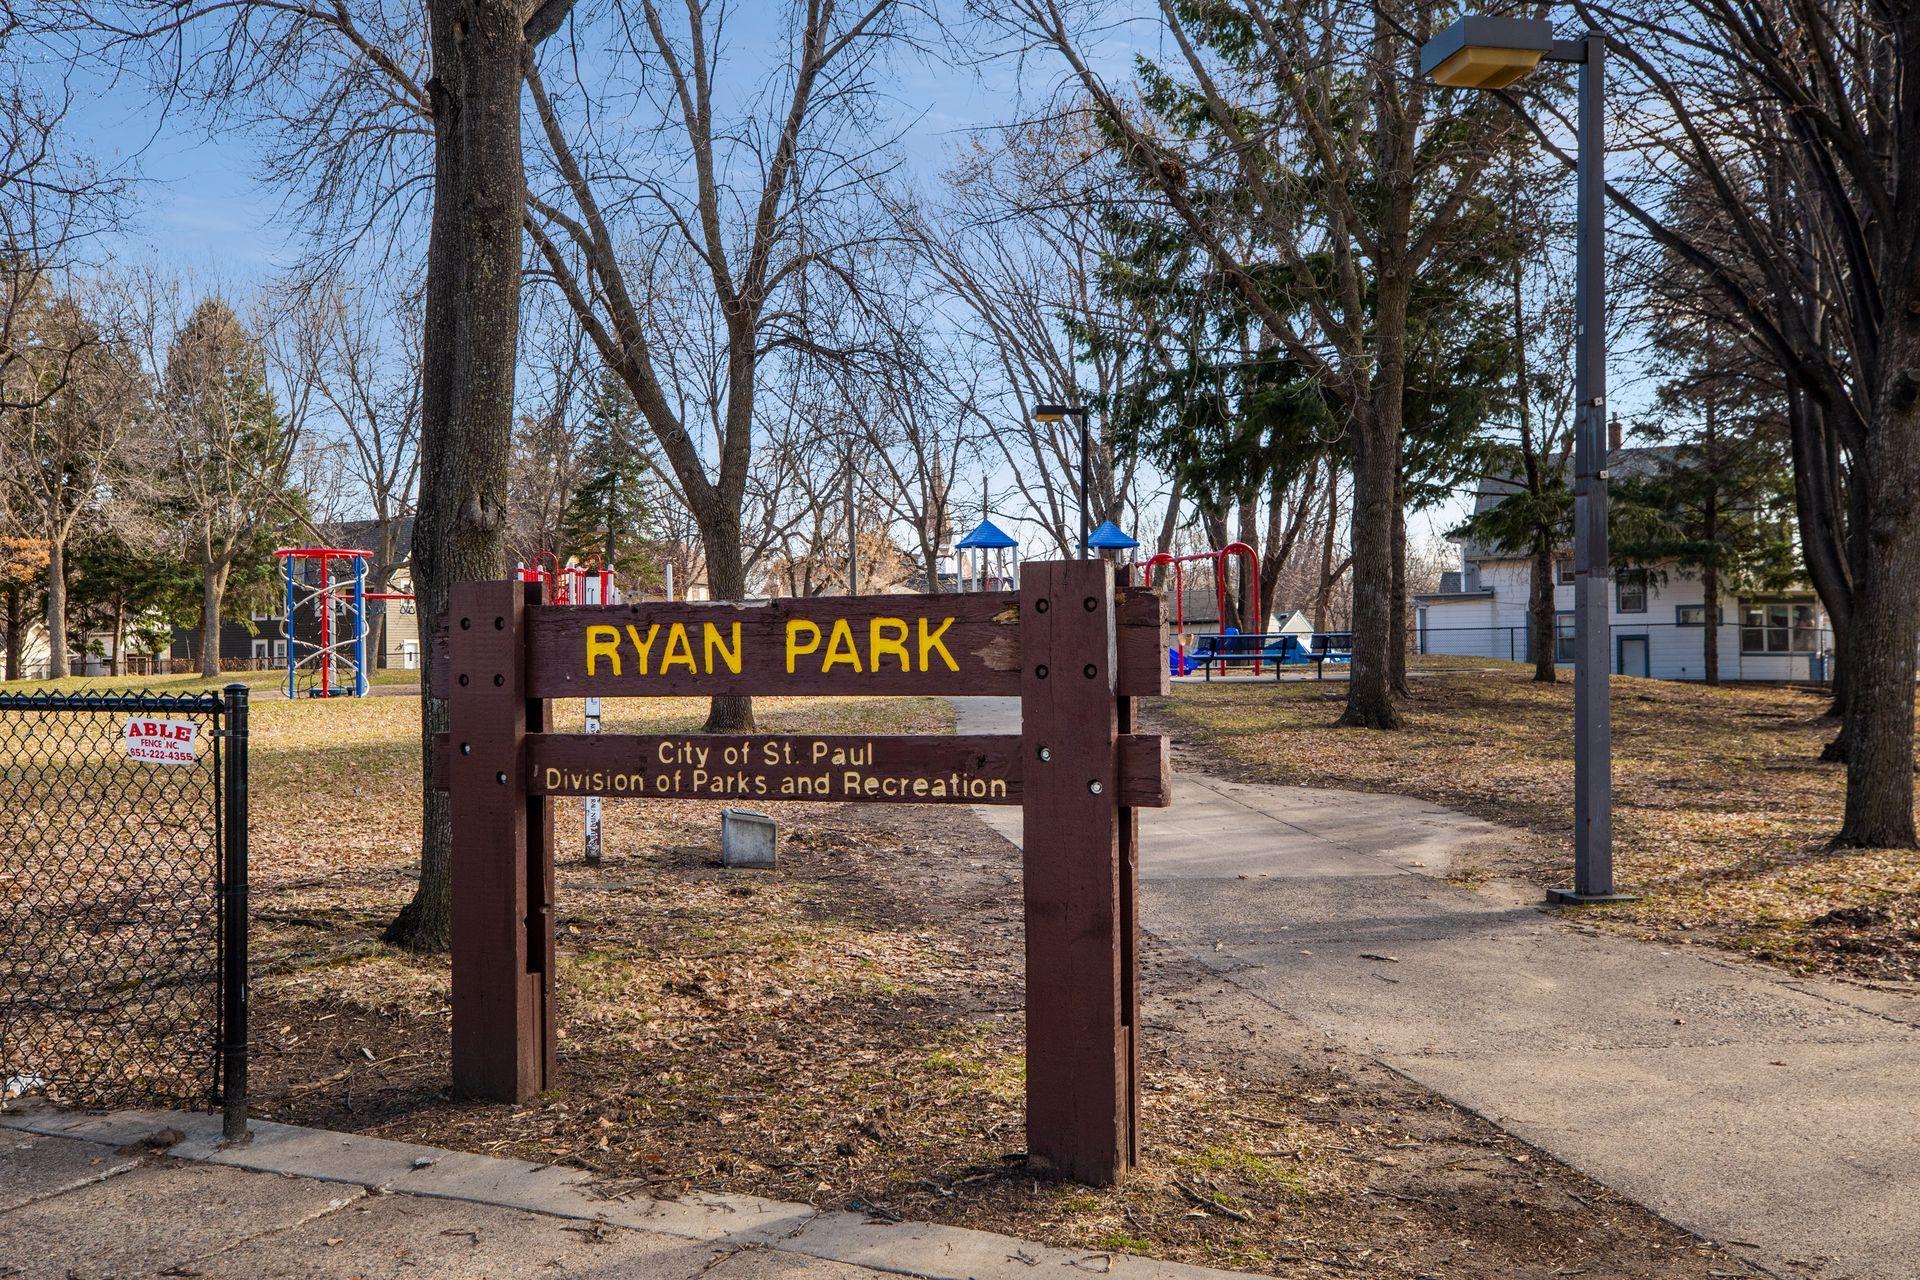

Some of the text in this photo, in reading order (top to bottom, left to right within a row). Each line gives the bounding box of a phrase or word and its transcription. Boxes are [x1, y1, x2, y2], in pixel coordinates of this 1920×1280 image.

[586, 617, 960, 676] RYAN PARK
[129, 723, 192, 742] ABLE
[140, 739, 162, 748] FENCE
[658, 741, 709, 768] City
[724, 741, 751, 766] of
[812, 741, 873, 766] Paul
[545, 767, 1008, 799] Division of Parks and Recreation
